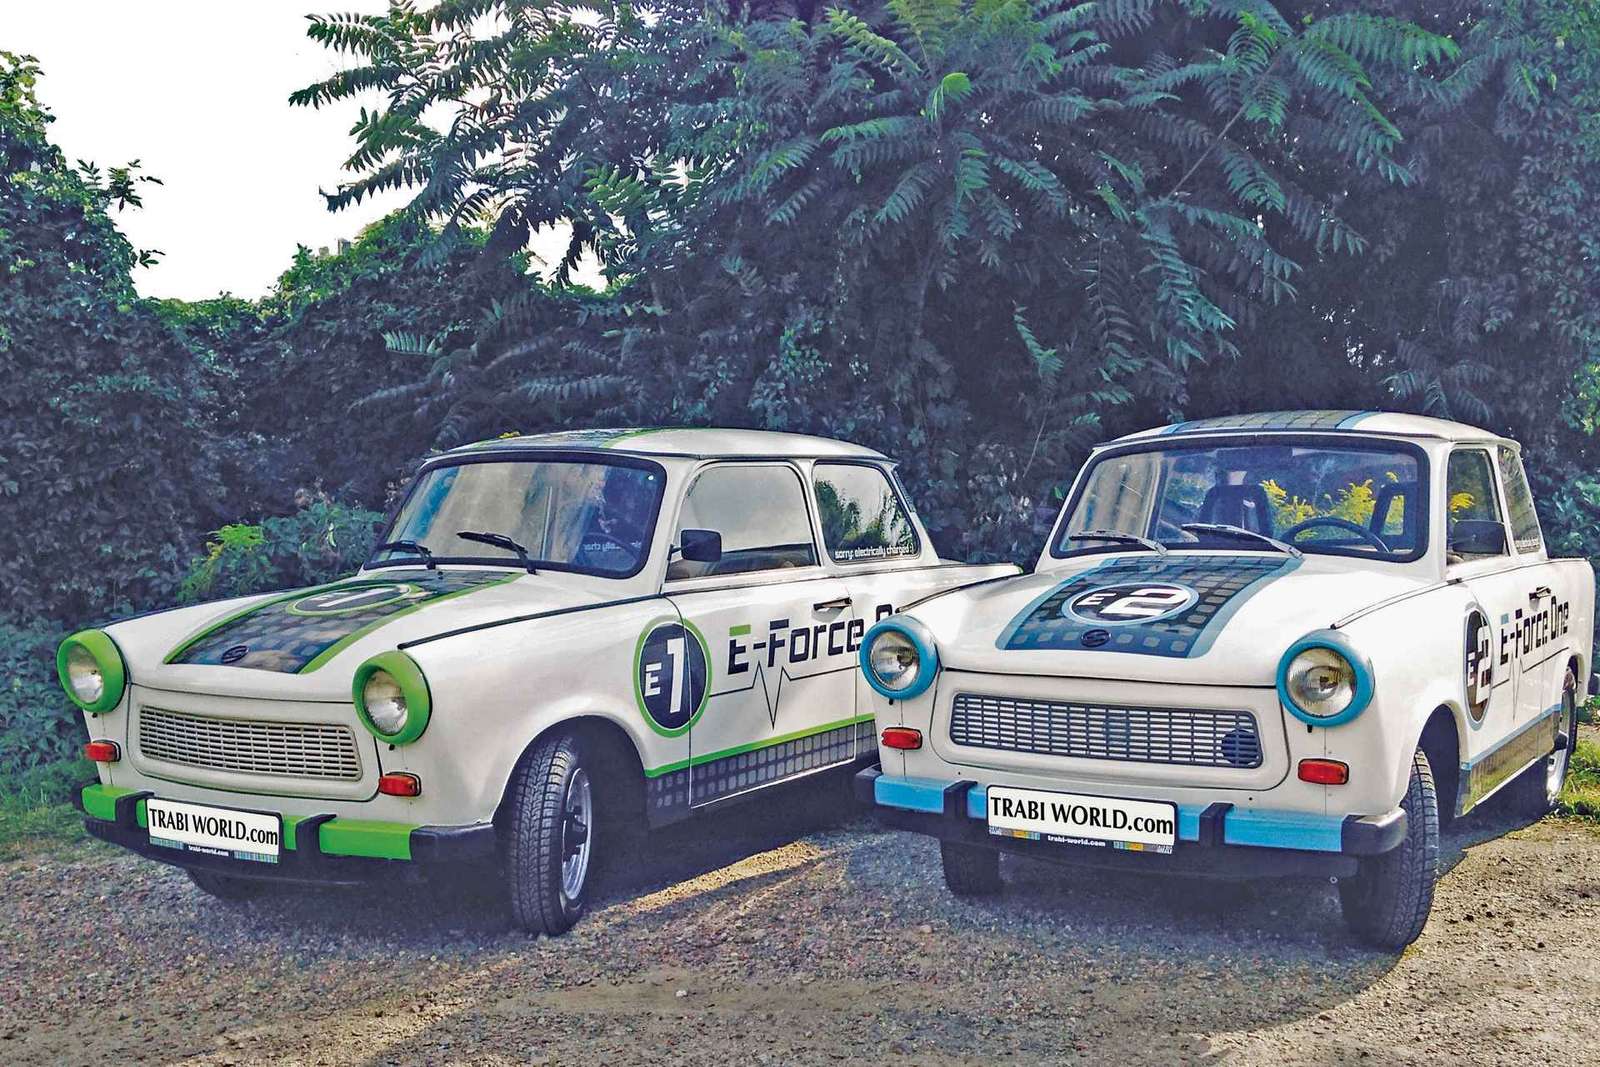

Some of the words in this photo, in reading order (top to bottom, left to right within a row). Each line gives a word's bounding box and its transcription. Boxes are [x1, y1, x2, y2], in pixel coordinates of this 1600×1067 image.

[854, 546, 886, 557] electrically
[728, 618, 865, 675] E-Force
[1500, 608, 1548, 666] E-Force
[1550, 595, 1569, 640] One
[149, 808, 189, 832] TRABI
[192, 814, 278, 846] WORLD.com
[990, 797, 1045, 821] TRABI
[1051, 803, 1174, 835] WORLD.com
[1047, 834, 1106, 847] trabi-world.com
